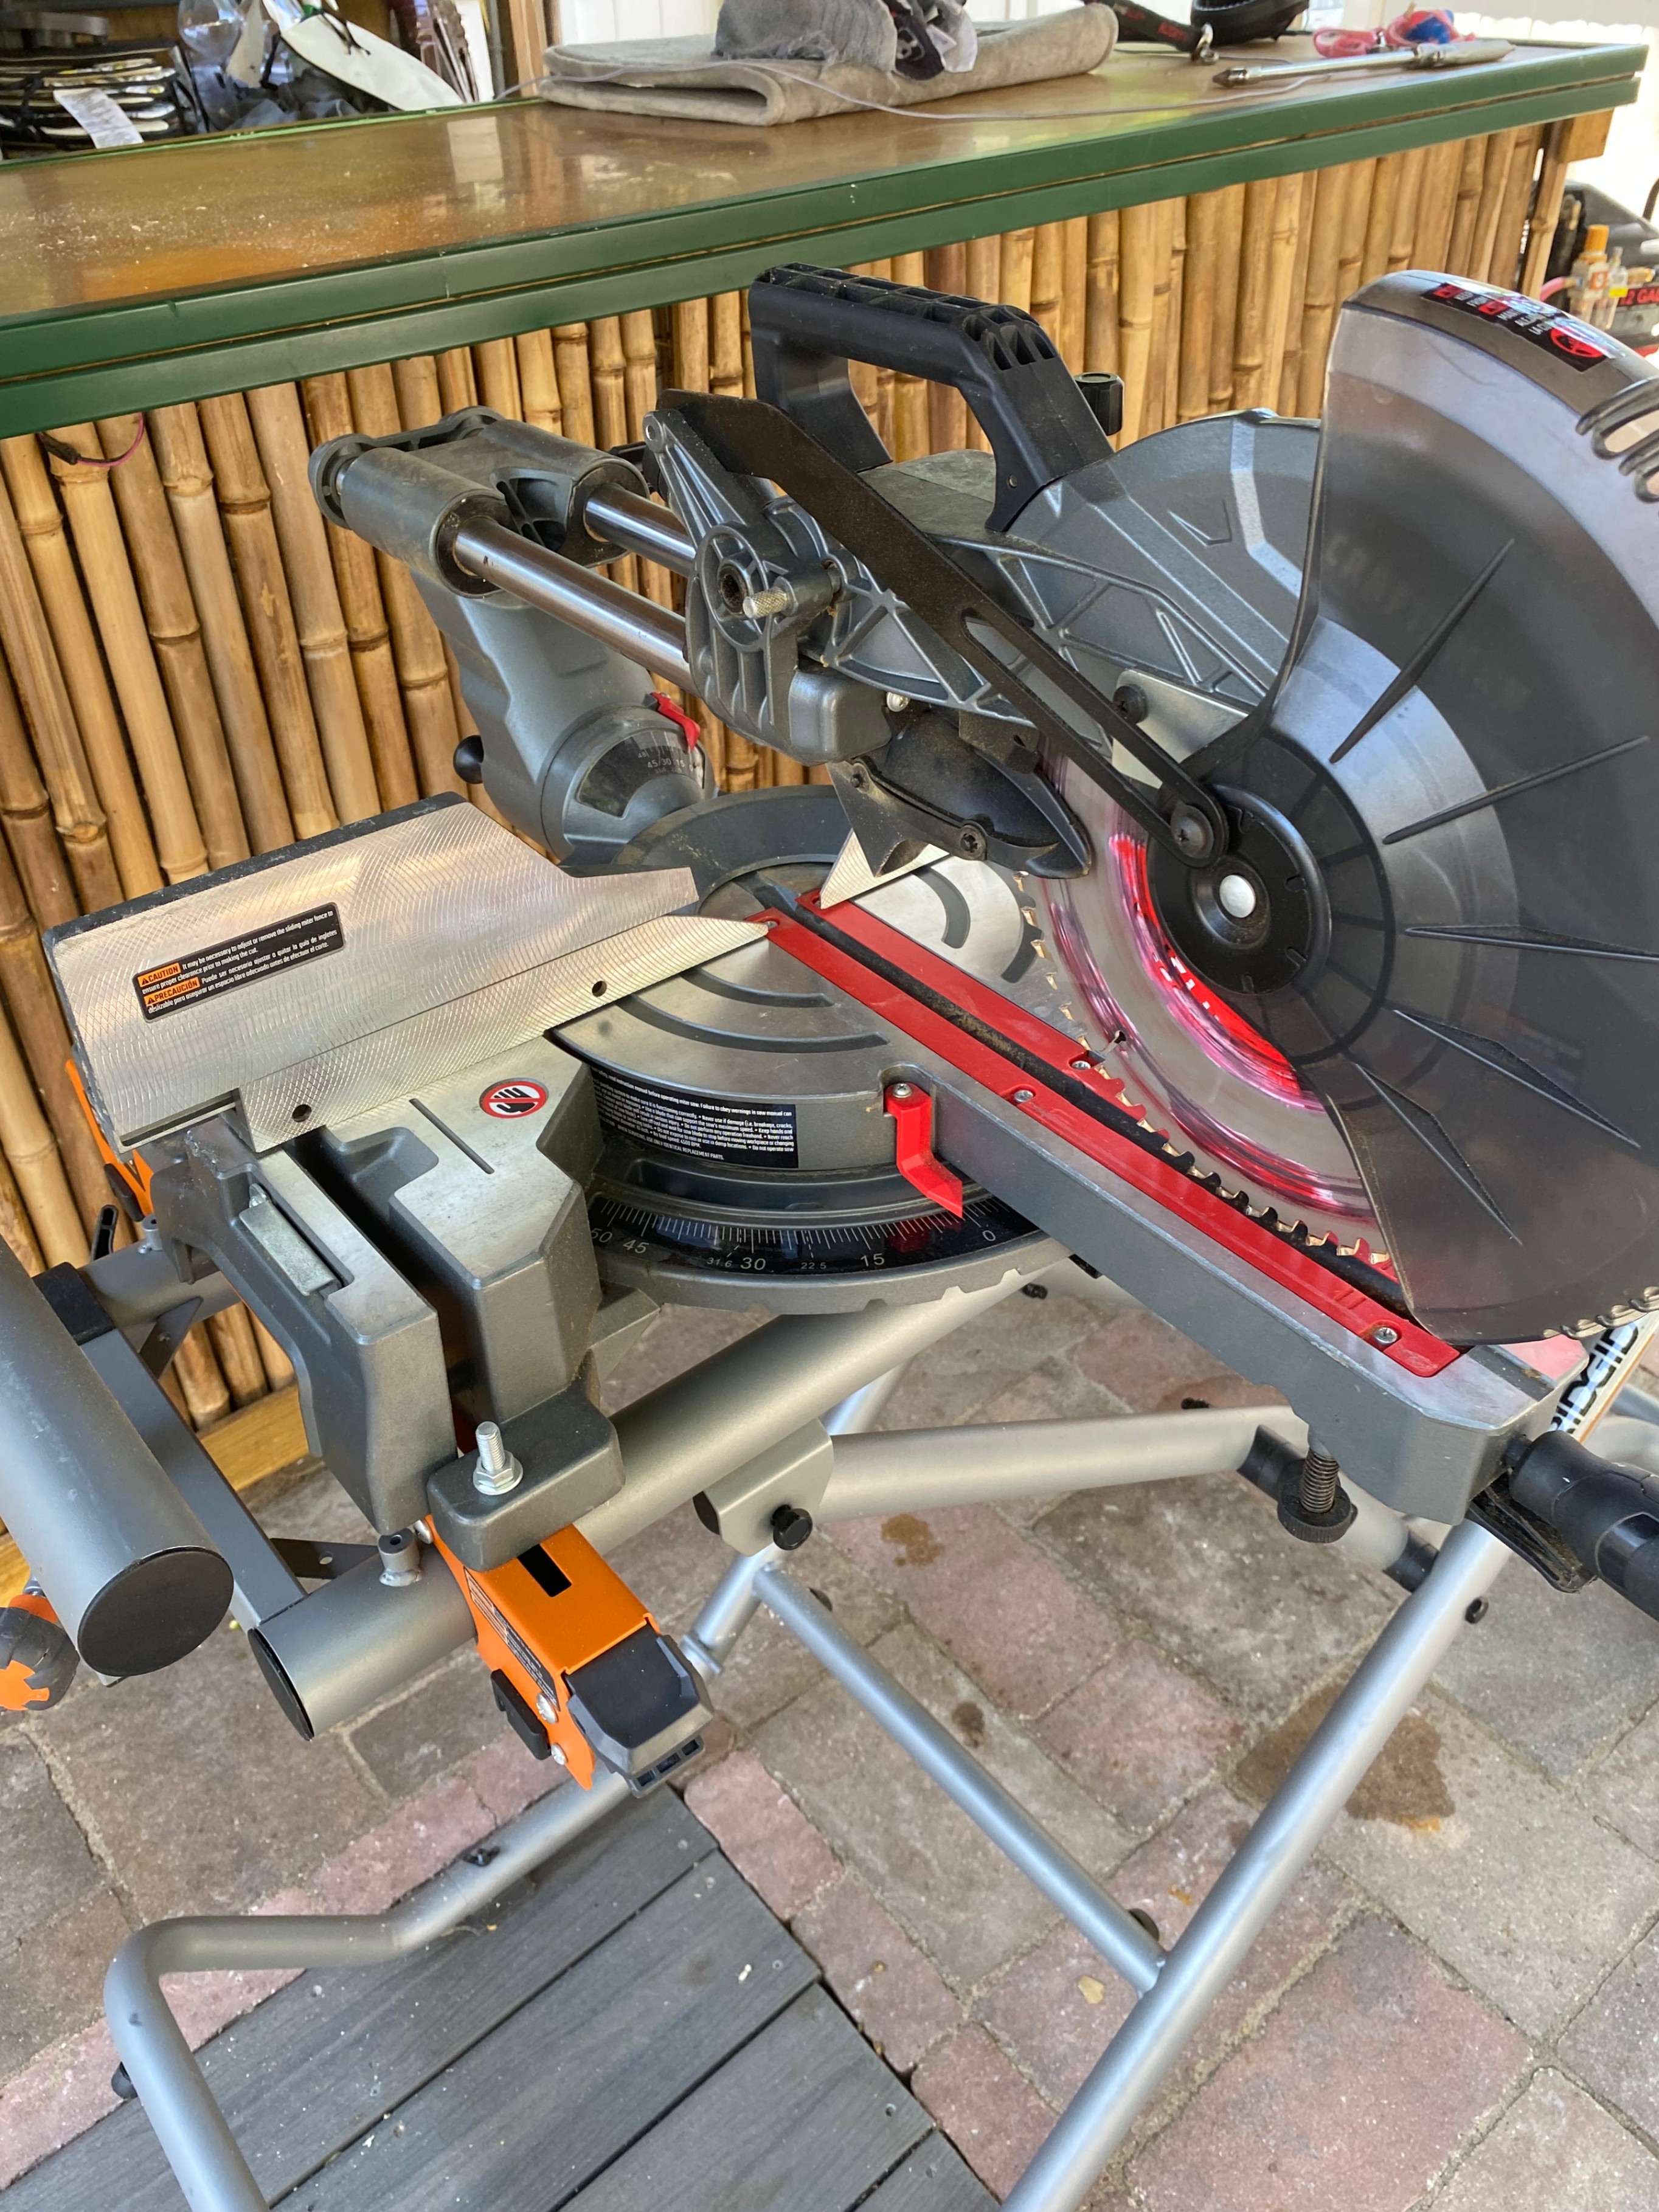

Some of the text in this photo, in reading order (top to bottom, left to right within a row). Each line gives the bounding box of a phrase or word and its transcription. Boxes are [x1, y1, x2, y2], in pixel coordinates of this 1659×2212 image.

[647, 759, 658, 768] 45
[676, 759, 685, 767] 15
[148, 966, 179, 982] CAUTION
[206, 949, 231, 961] necessary
[237, 940, 252, 950] adjust
[258, 931, 277, 942] remove
[285, 922, 302, 932] sliding
[314, 913, 327, 921] fence
[154, 980, 198, 1001] PRECAUCIÓN
[201, 974, 218, 984] Puede
[228, 961, 252, 974] necesario
[254, 955, 271, 964] ajustar
[277, 947, 291, 956] quitar
[318, 930, 338, 941] ingletes
[142, 984, 160, 994] ensure
[160, 978, 177, 989] proper
[178, 969, 203, 981] clearance
[203, 964, 215, 973] prior
[221, 955, 240, 965] making
[148, 1000, 173, 1014] deslizable
[174, 995, 185, 1005] para
[185, 988, 207, 999] asegurar
[215, 977, 234, 988] espacio
[246, 964, 269, 976] adecuado
[269, 958, 283, 967] antes
[290, 949, 310, 960] efectuar
[591, 1228, 612, 1243] 50
[623, 1239, 649, 1254] 45
[706, 1257, 732, 1267] 31.6
[740, 1257, 766, 1270] 30
[861, 1253, 885, 1267] 15
[982, 1230, 996, 1241] 0
